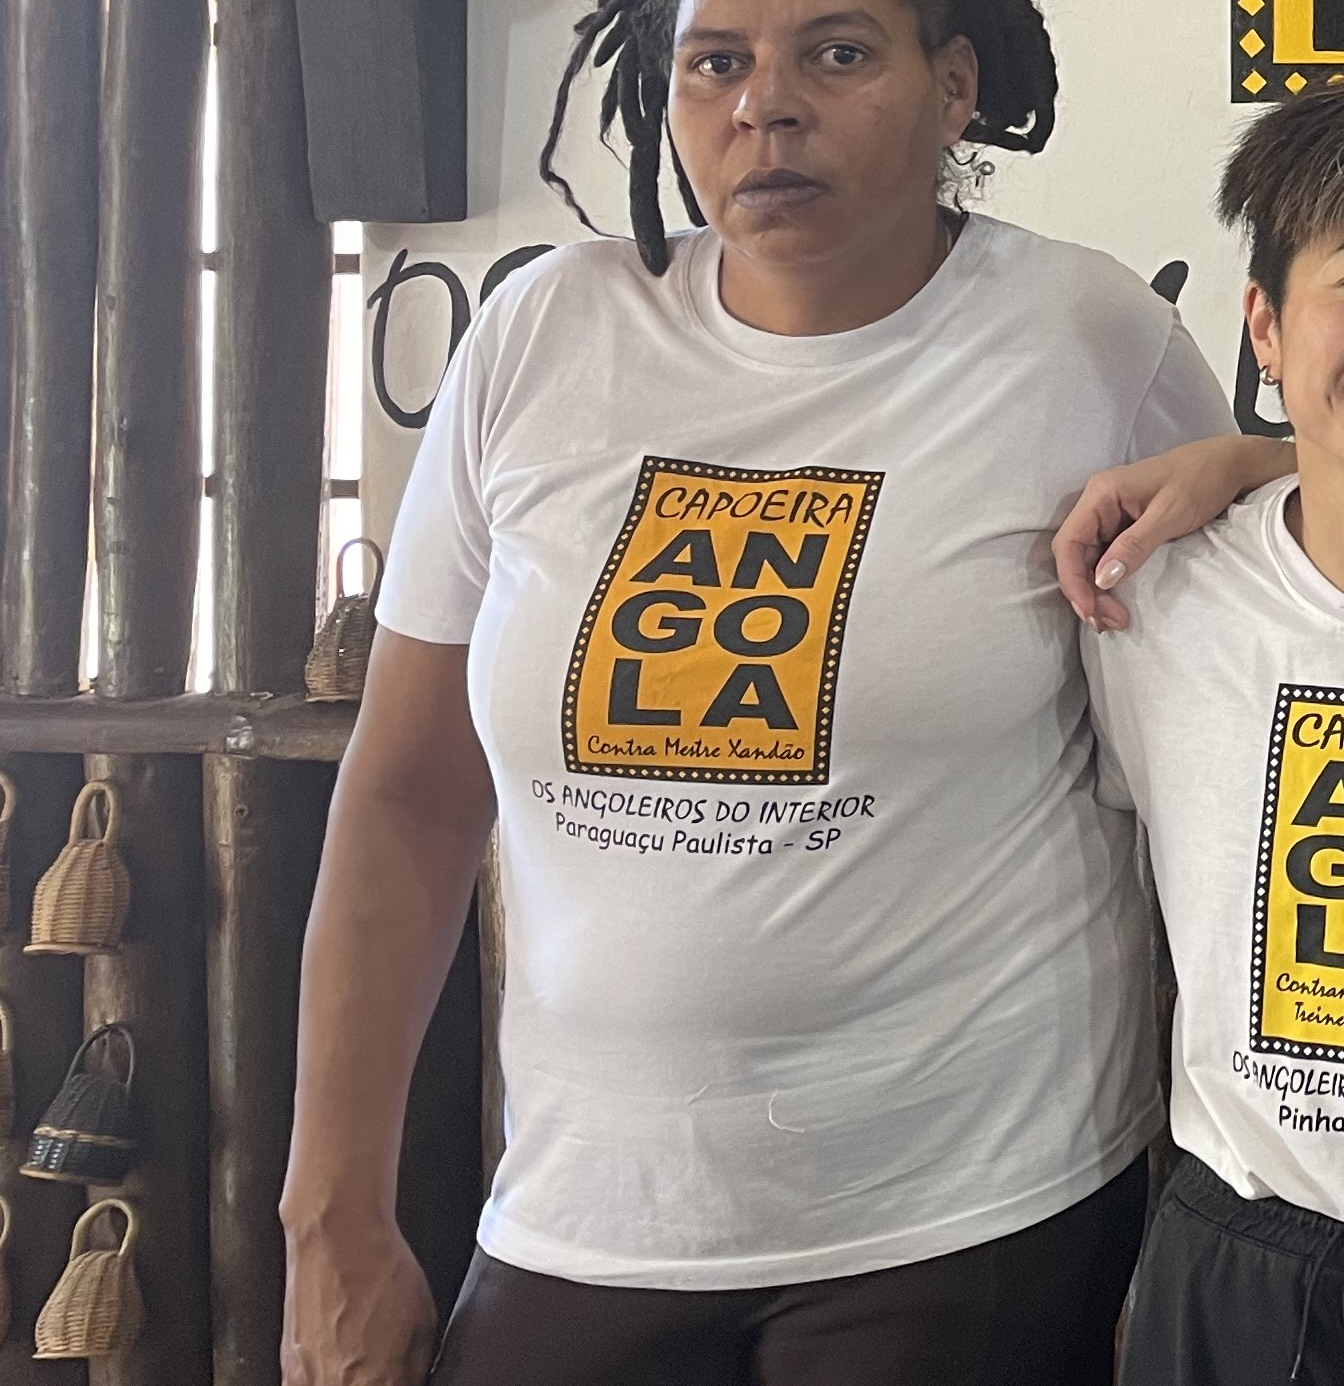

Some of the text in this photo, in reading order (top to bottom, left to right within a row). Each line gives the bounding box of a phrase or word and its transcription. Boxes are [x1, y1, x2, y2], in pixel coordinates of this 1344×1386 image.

[367, 248, 557, 429] O
[656, 487, 853, 527] CAPOEIRA
[629, 529, 830, 589] AN
[611, 590, 810, 657] GO
[608, 658, 799, 730] LA
[587, 734, 805, 761] Contra Mestre Xandão
[532, 780, 875, 823] OS ANGOLEIROS DO INTERIOR
[556, 812, 664, 854] Paraguaçu
[672, 830, 773, 855] Paulista
[805, 827, 841, 851] SP
[1233, 1051, 1250, 1079] OS
